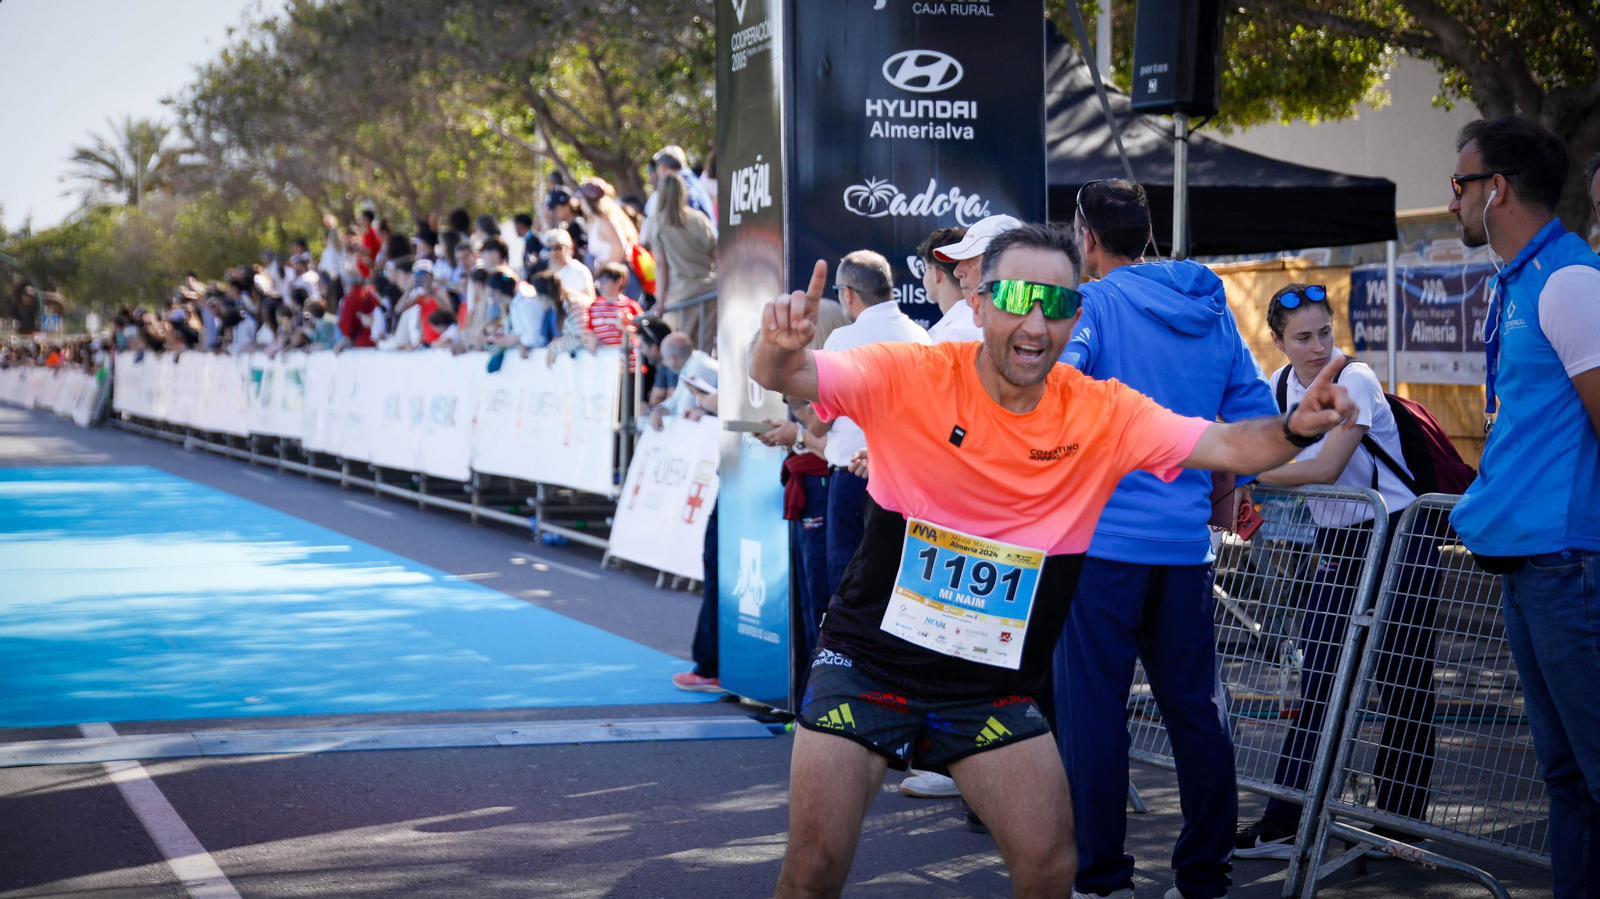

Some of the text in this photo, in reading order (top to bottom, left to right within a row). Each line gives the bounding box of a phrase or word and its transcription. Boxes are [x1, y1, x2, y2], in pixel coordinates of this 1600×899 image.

[912, 2, 994, 17] CAJA RURAL
[865, 98, 977, 119] HYUNDAI
[869, 120, 974, 140] Almerialva
[889, 178, 989, 227] adora
[1411, 319, 1457, 343] Almería
[949, 540, 999, 559] Almería 2024
[951, 534, 1000, 552] Media Maratón
[918, 545, 1023, 602] 1191
[938, 588, 986, 609] MI NAIM
